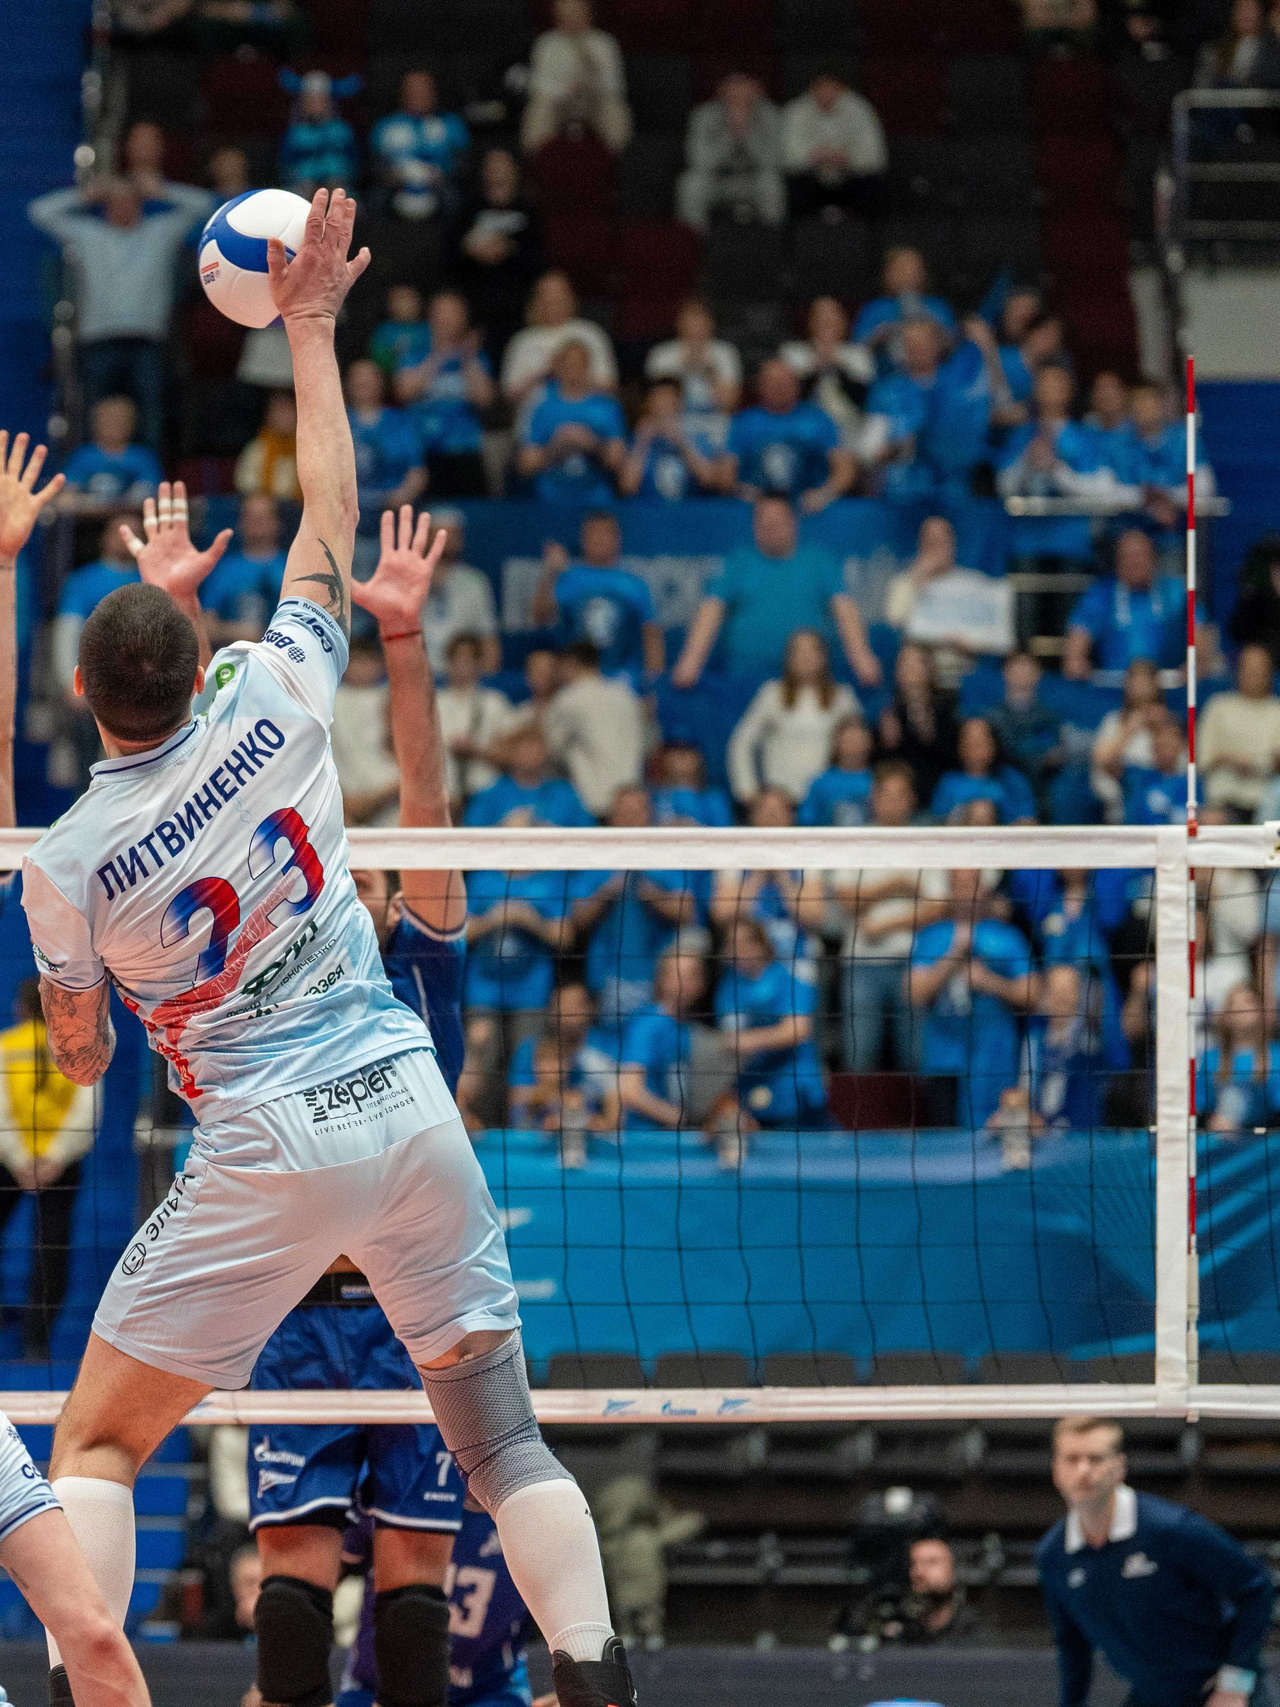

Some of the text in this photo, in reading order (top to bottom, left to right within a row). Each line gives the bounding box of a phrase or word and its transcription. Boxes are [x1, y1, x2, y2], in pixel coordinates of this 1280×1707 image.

[96, 718, 286, 902] ЛИТВИНЕНКО
[160, 806, 326, 982] 23
[435, 1451, 452, 1487] 7
